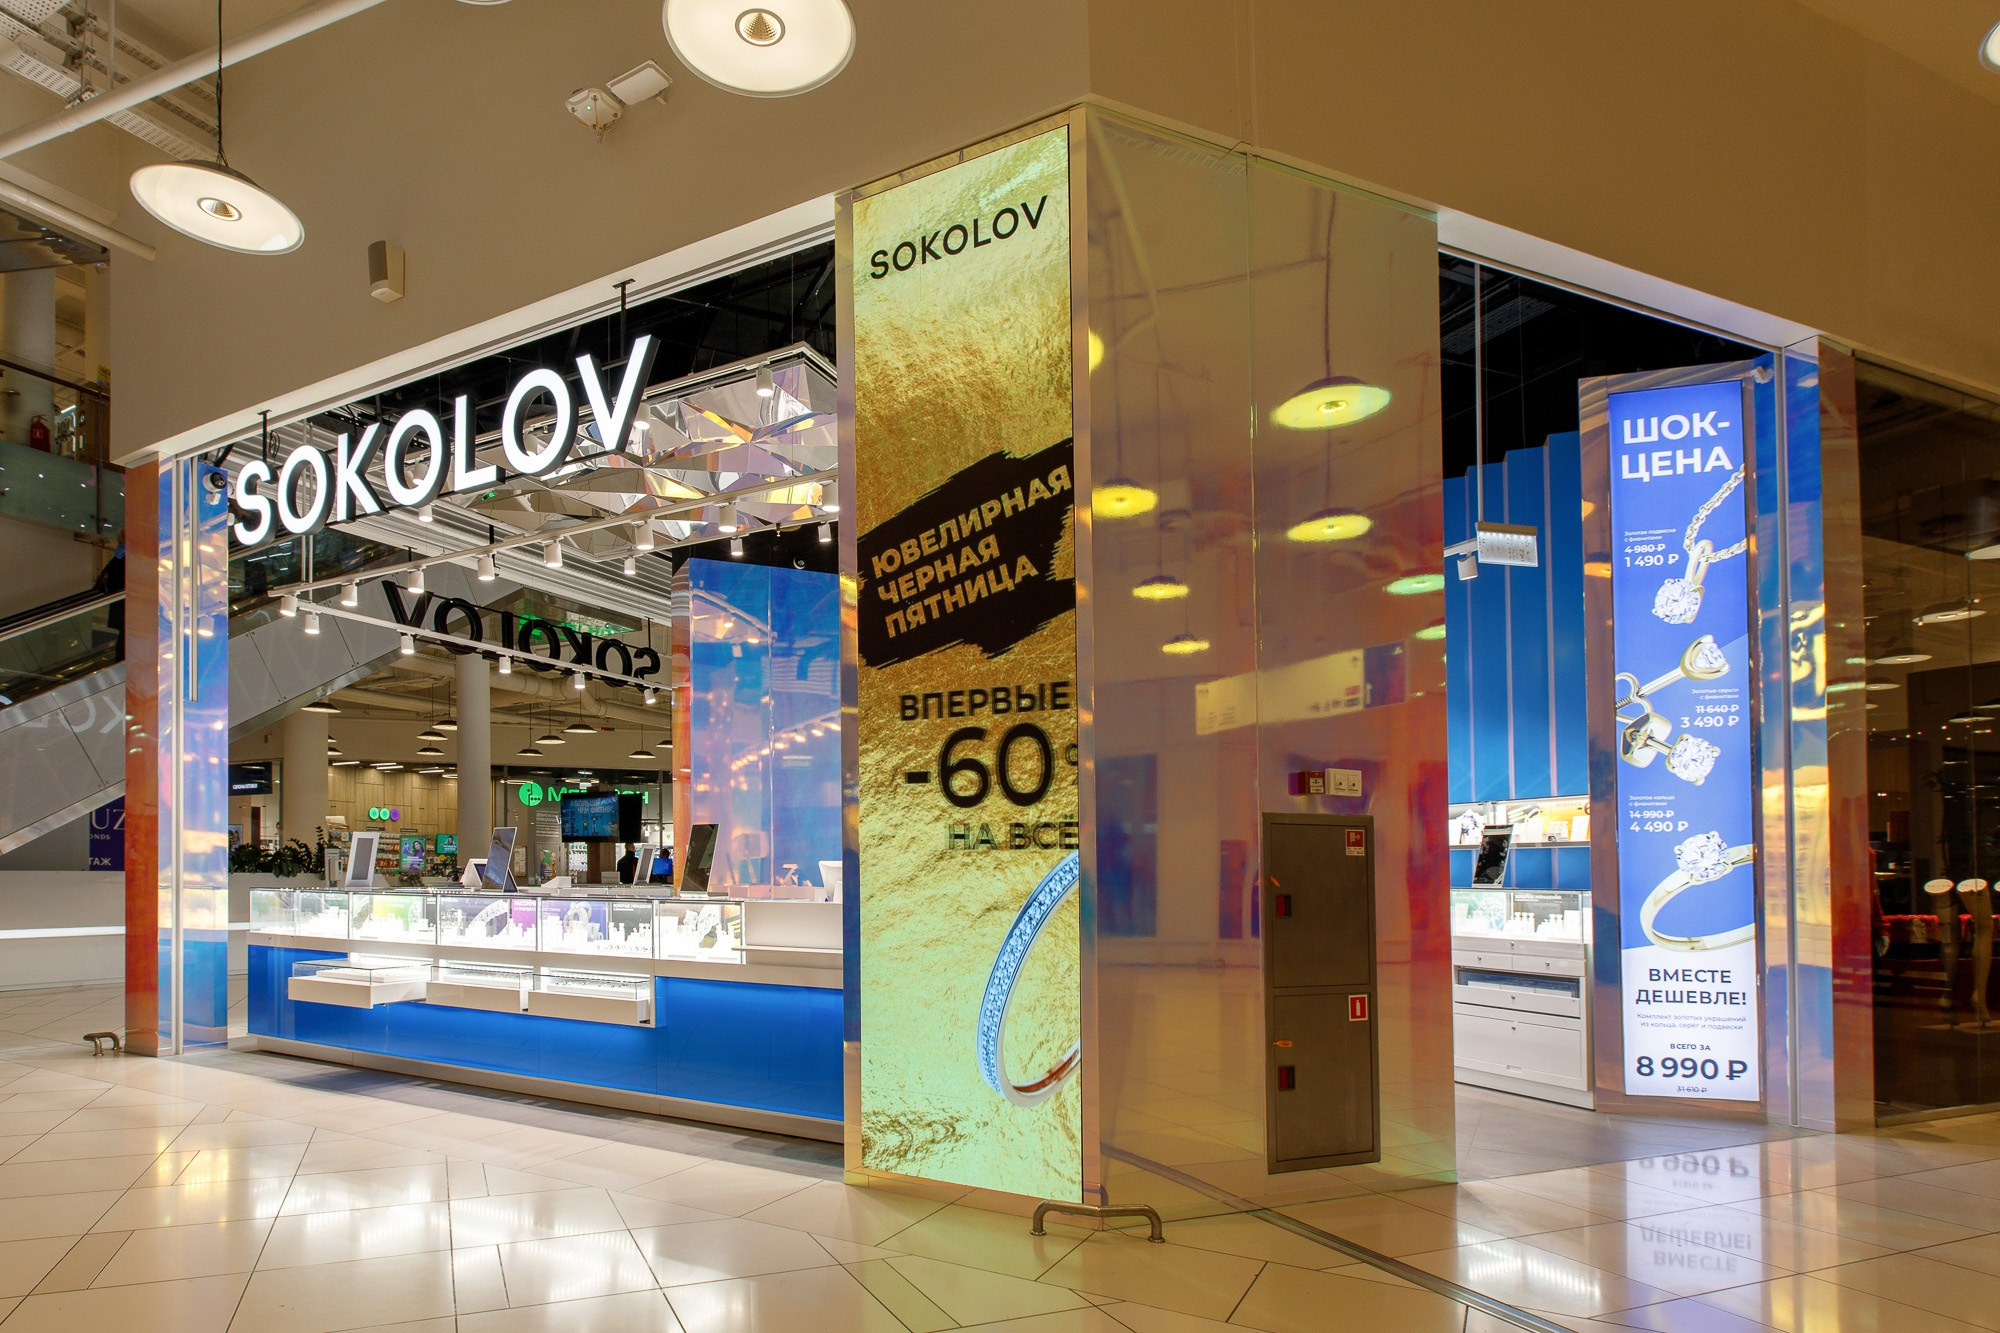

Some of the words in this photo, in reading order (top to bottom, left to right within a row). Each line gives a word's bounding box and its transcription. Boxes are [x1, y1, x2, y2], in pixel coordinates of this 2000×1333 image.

[870, 195, 1048, 280] SOKOLOV
[233, 334, 656, 546] SOKOLOV
[1623, 410, 1730, 445] ШОК-
[1621, 445, 1734, 482] ЦЕНА
[871, 464, 1072, 579] ЮВЕЛИРНАЯ
[877, 533, 1000, 604] ЧЕРНАЯ
[1624, 556, 1631, 568] 1
[1634, 554, 1664, 567] 490
[885, 554, 1039, 639] ПЯТНИЦА
[901, 681, 1072, 721] ВПЕРВЫЕ
[1680, 716, 1690, 728] 3
[1693, 715, 1724, 728] 490
[948, 823, 998, 851] НА
[1630, 821, 1641, 832] 4
[1643, 820, 1673, 833] 490
[1648, 968, 1732, 984] ВМЕСТЕ
[1635, 989, 1747, 1006] ДЕШЕВЛЕ!
[1636, 1056, 1655, 1077] 8
[1660, 1056, 1719, 1080] 990
